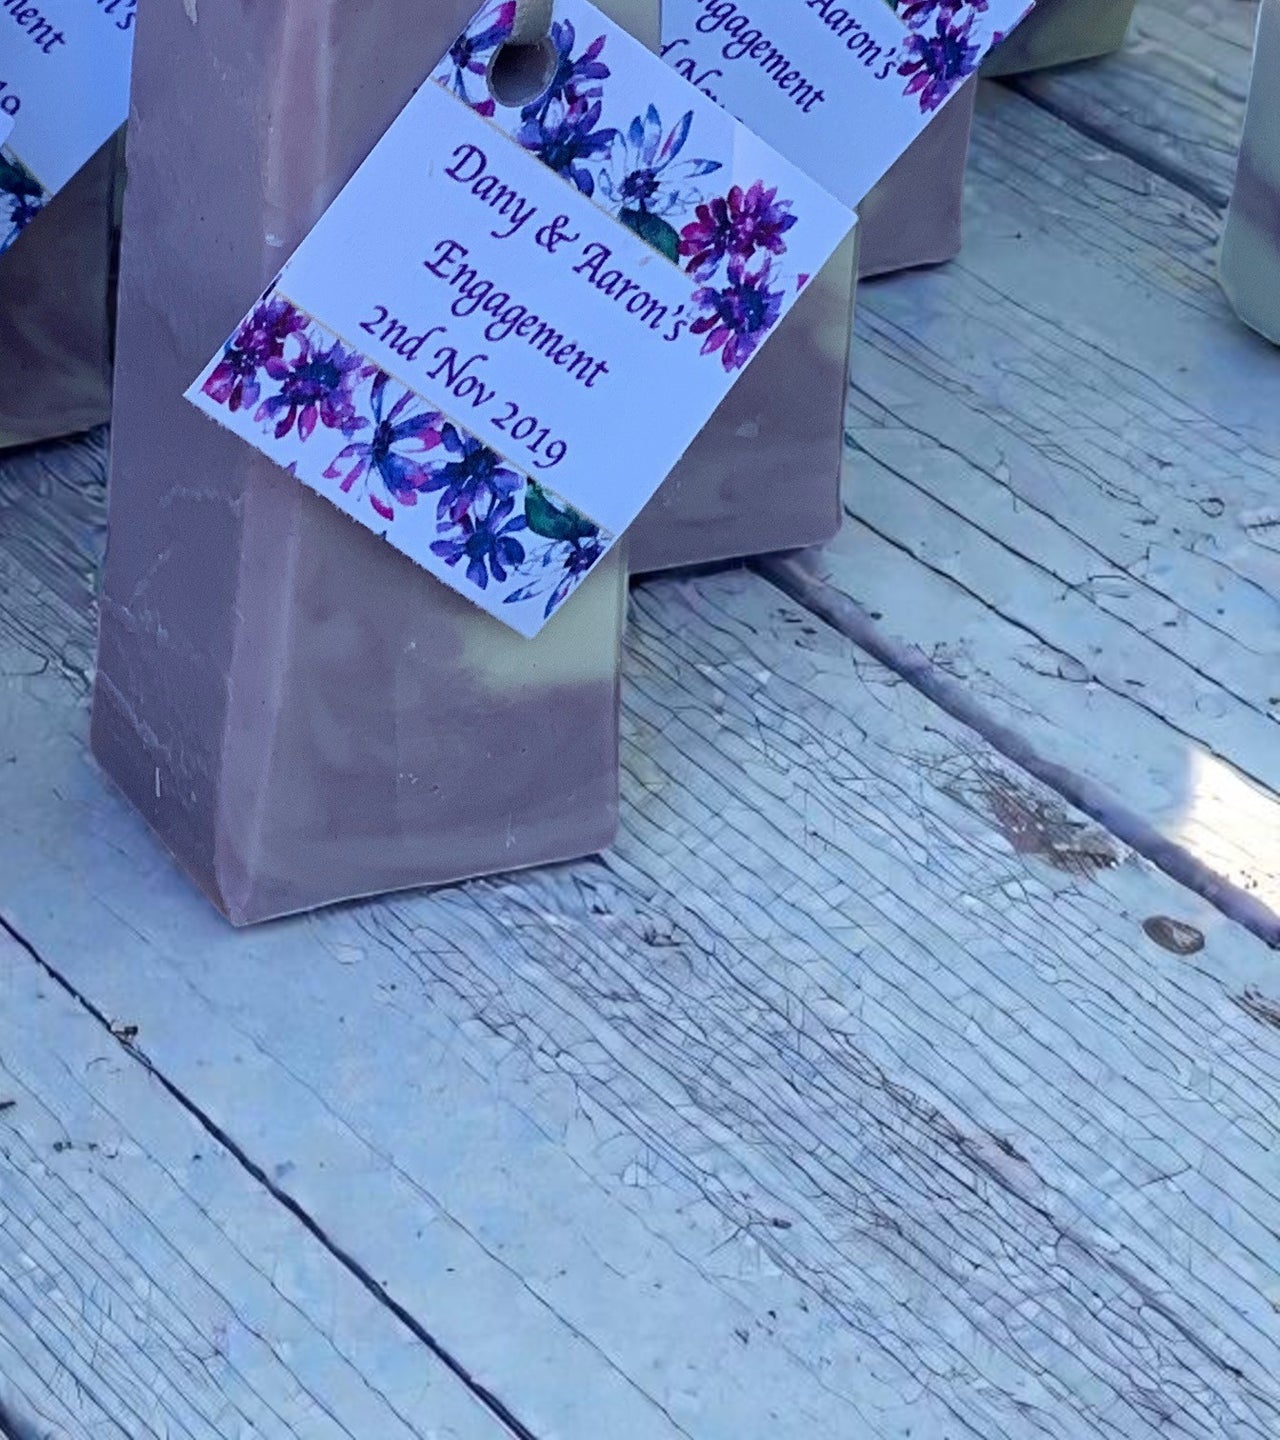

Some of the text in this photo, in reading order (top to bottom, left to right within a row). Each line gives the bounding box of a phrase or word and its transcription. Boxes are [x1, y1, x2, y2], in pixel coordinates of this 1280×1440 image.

[423, 239, 610, 388] Engagement
[445, 143, 693, 343] Dany & Aaron's
[360, 305, 567, 468] 2nd Nov 2019
